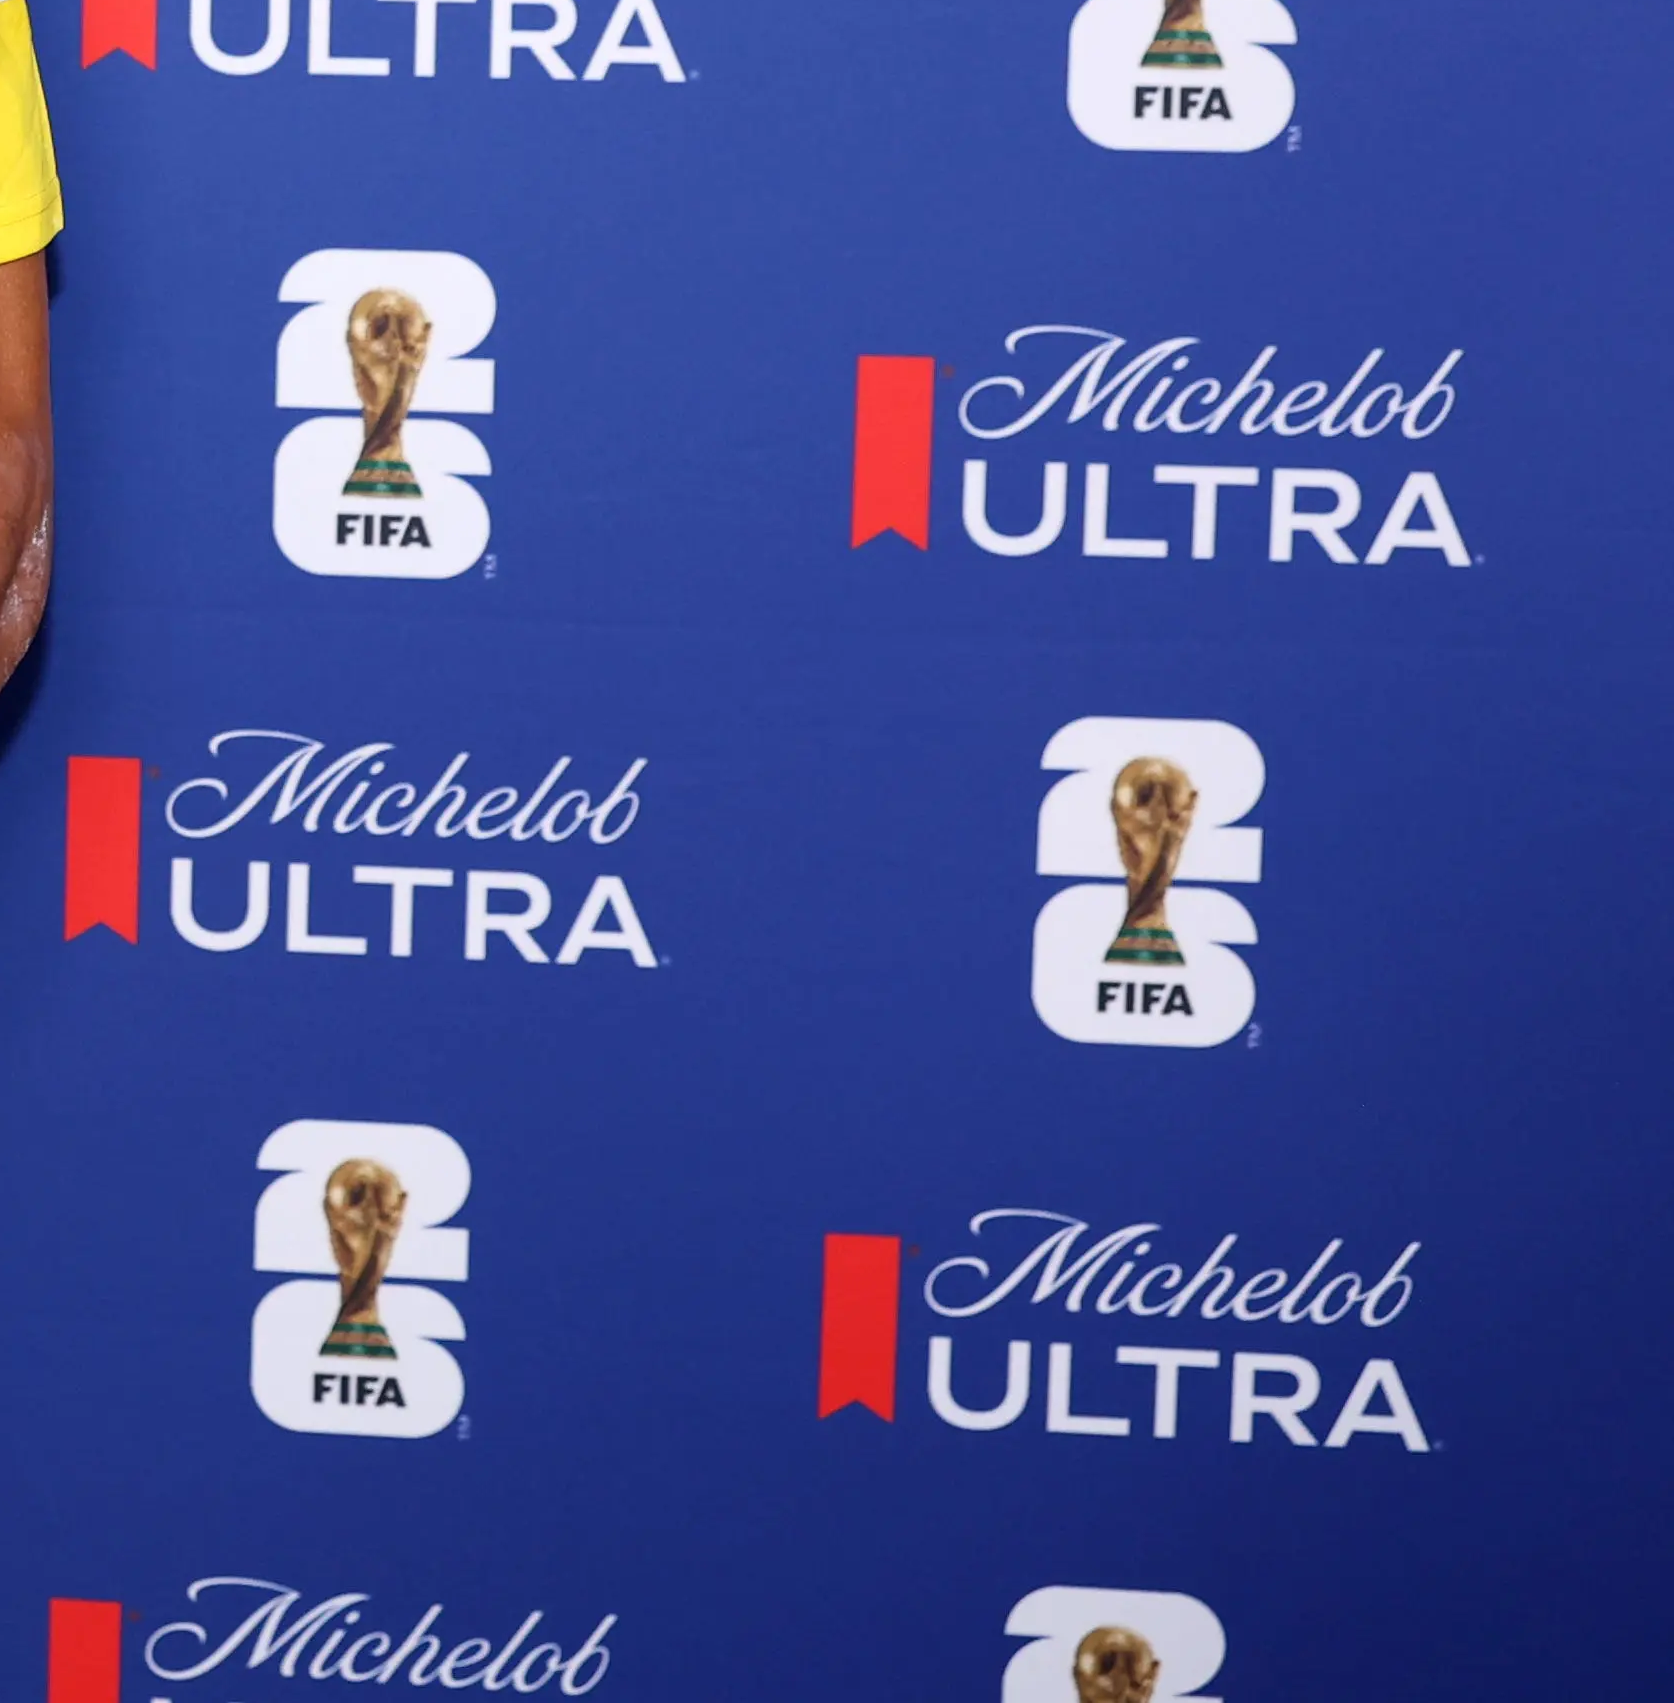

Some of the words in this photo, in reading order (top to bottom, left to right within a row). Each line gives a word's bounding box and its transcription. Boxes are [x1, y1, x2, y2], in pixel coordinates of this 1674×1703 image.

[1134, 86, 1231, 120] FIFA
[959, 325, 1463, 439] Michelob
[336, 514, 430, 547] FIFA
[962, 459, 1471, 567] ULTRA
[165, 730, 647, 844] Michelob
[170, 858, 657, 967] ULTRA
[1097, 981, 1193, 1016] FIFA
[925, 1209, 1420, 1326] Michelob
[313, 1373, 406, 1407] FIFA
[928, 1336, 1428, 1451] ULTRA
[145, 1577, 616, 1695] Michelob
